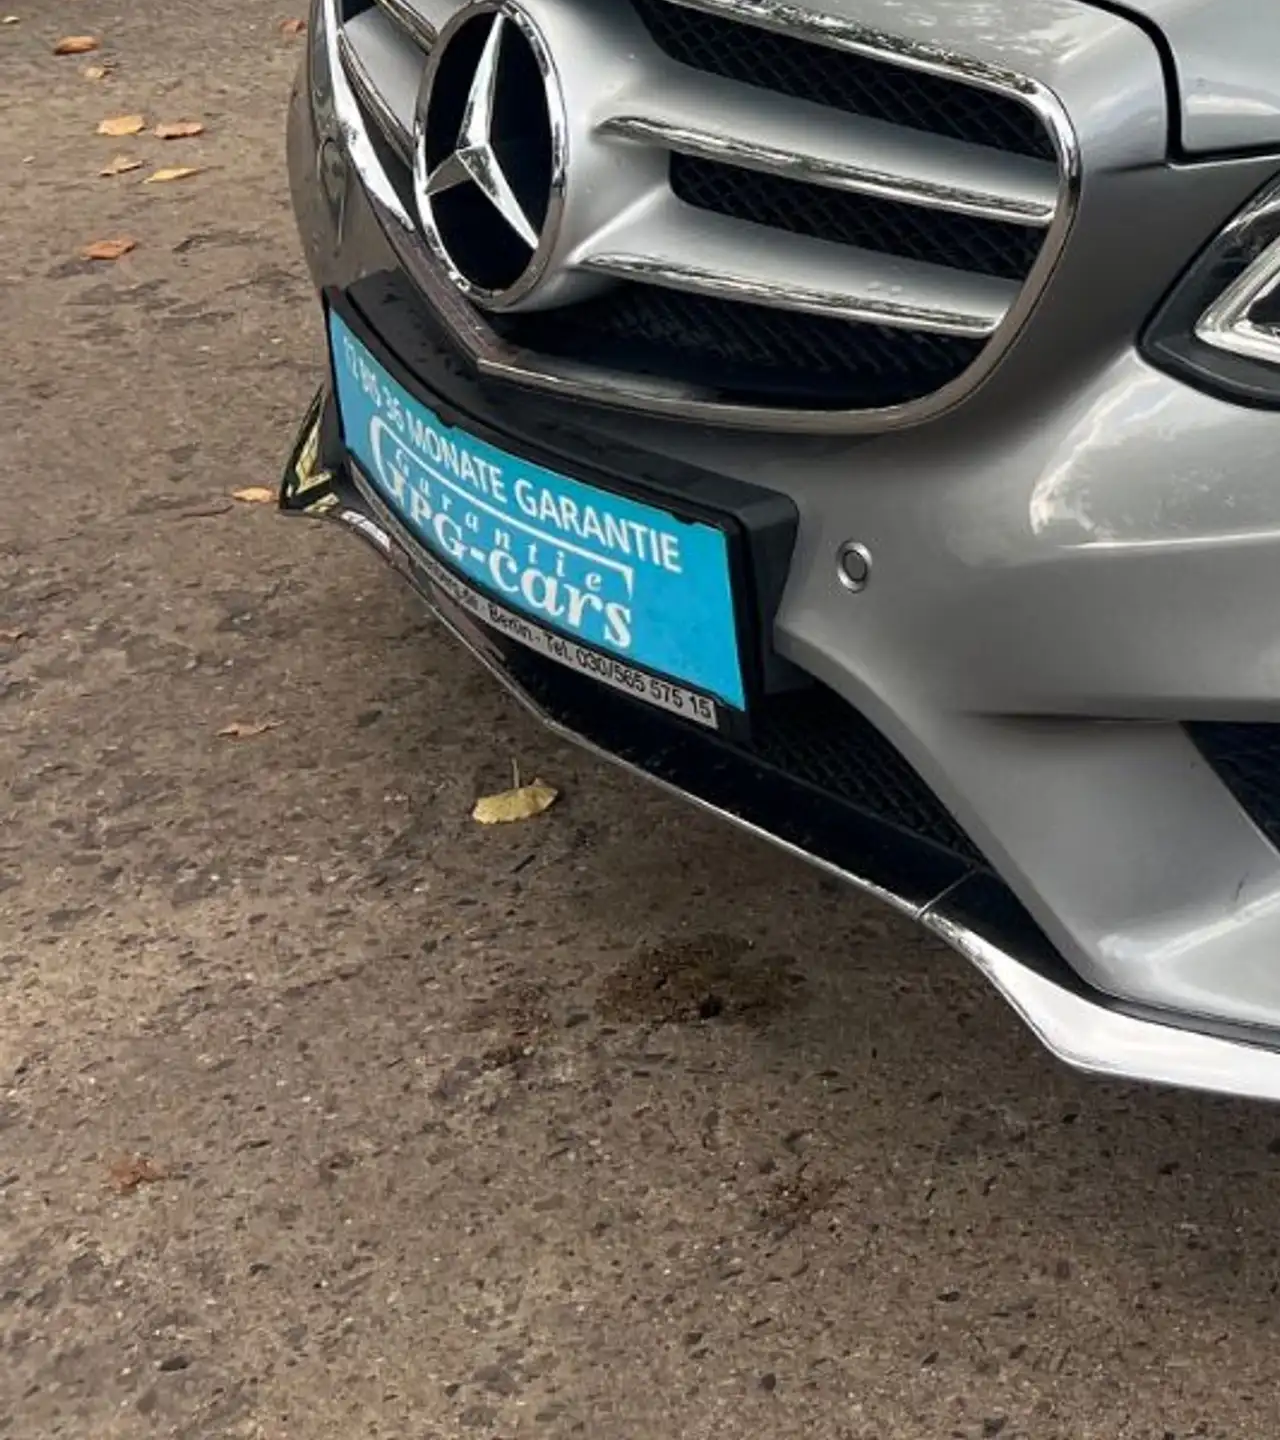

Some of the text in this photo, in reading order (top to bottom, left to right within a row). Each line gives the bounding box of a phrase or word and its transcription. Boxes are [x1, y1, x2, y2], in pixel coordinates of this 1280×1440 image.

[406, 407, 508, 503] MONATE
[515, 478, 683, 574] GARANTIE
[690, 693, 713, 719] 15
